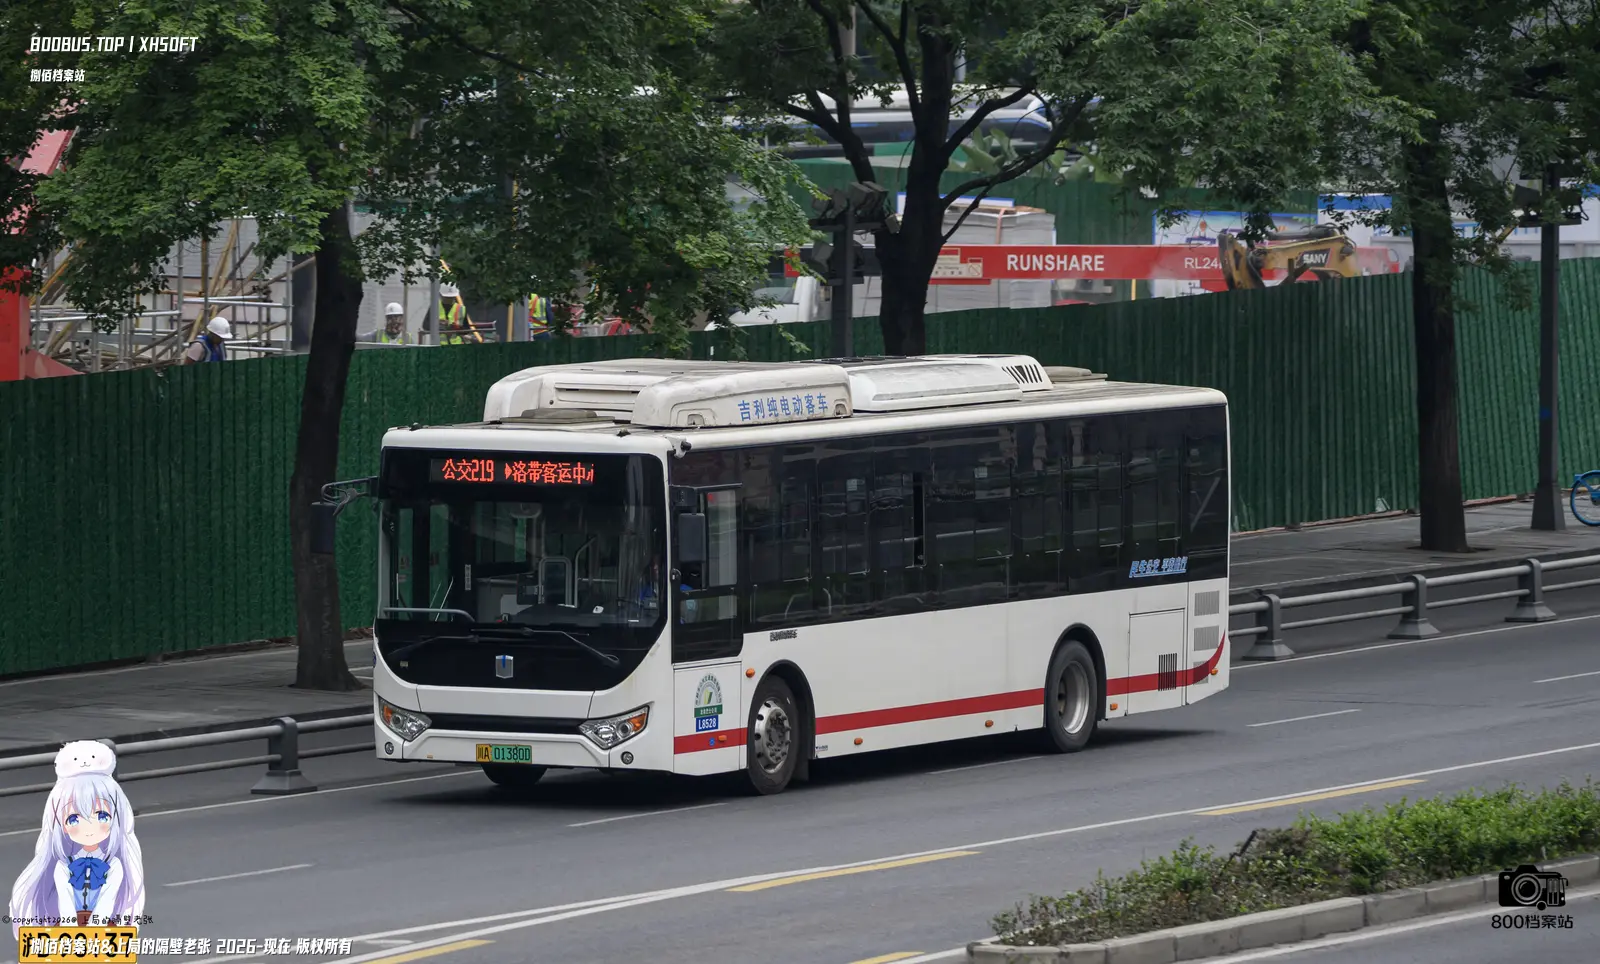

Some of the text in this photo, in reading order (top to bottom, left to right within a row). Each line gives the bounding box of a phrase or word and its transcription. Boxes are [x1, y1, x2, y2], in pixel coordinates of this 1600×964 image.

[1006, 254, 1105, 271] RUNSHARE
[1184, 257, 1223, 269] RL24
[1302, 252, 1328, 264] SANY
[738, 392, 829, 422] 吉利纯电动客车
[442, 458, 494, 482] 公交219
[698, 717, 717, 730] L8528
